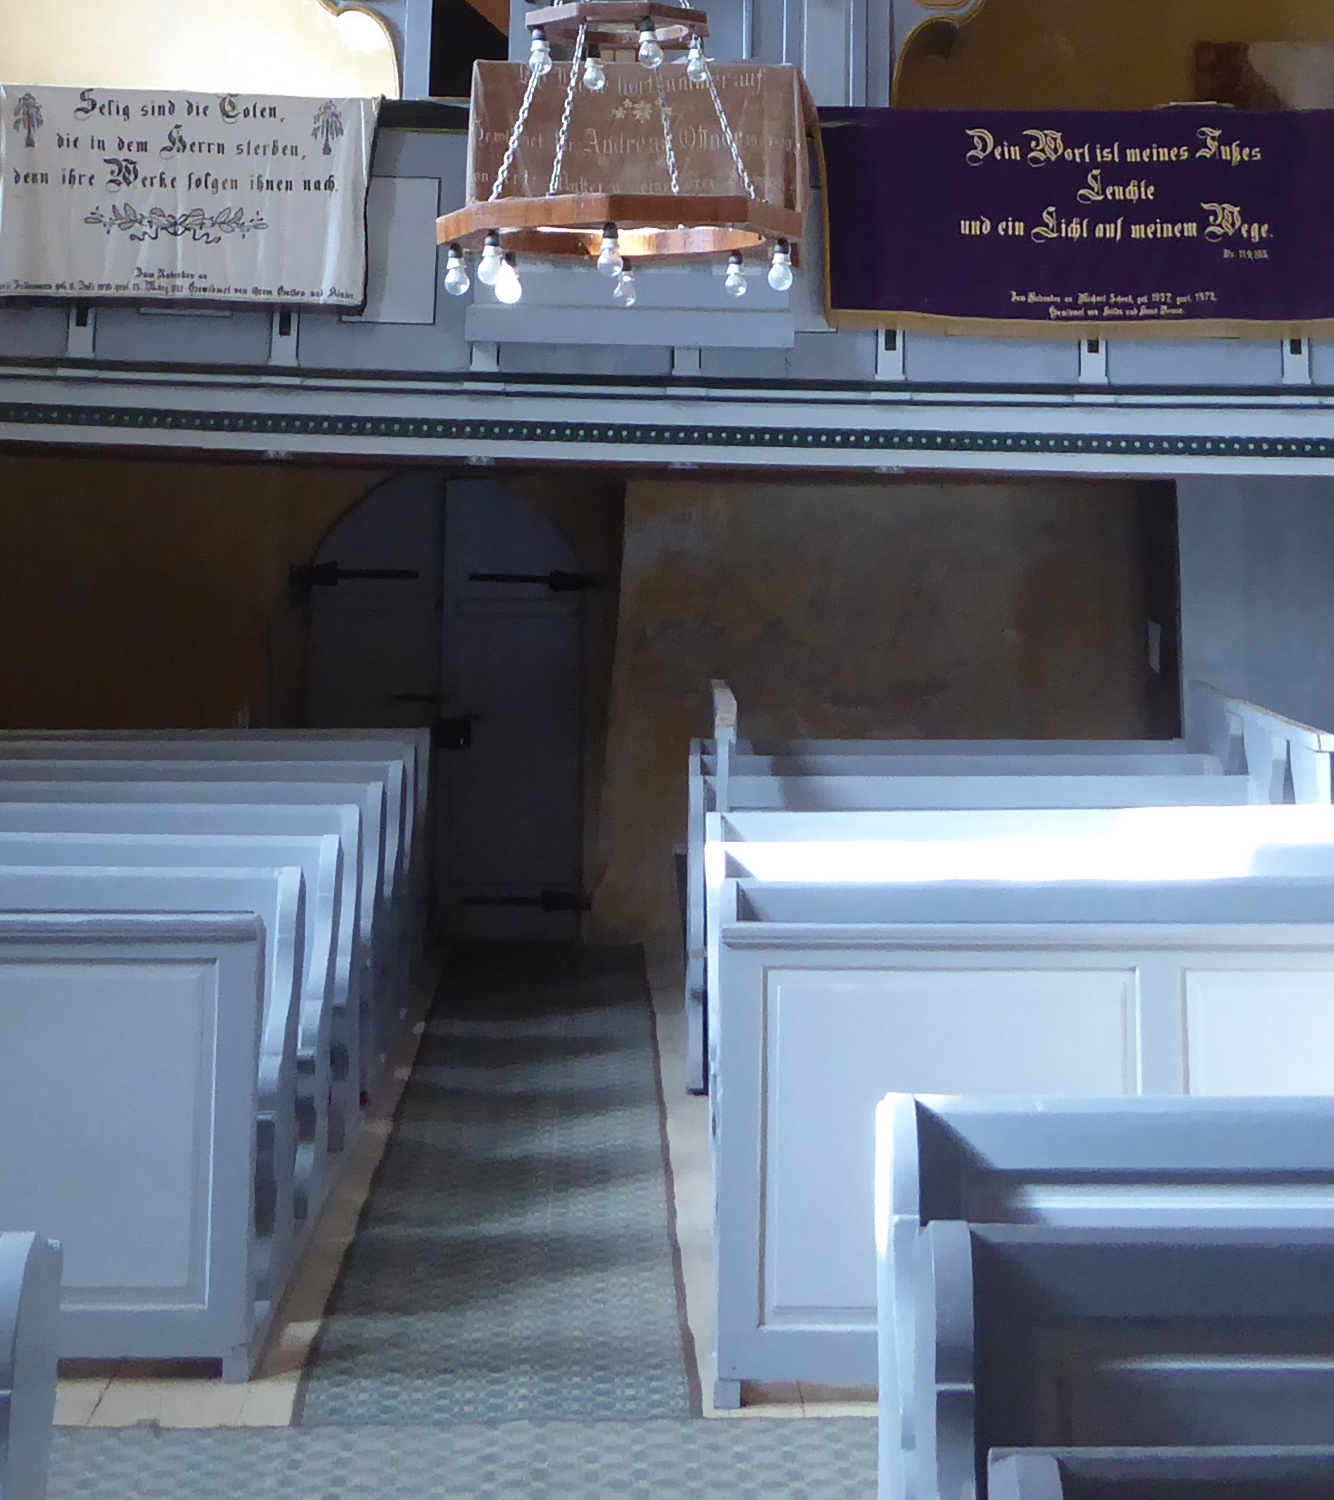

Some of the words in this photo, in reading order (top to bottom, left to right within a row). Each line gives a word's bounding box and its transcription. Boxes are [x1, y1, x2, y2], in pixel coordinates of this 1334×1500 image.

[73, 88, 130, 121] Selig
[141, 100, 176, 117] sind
[186, 100, 208, 117] die
[57, 133, 79, 149] die
[91, 134, 105, 150] in
[118, 136, 148, 152] dem
[159, 123, 225, 159] Herrn
[965, 128, 1020, 167] Dein
[1022, 129, 1091, 168] Wort
[1095, 141, 1120, 163] ist
[1126, 143, 1188, 163] meines
[1195, 127, 1262, 167] Fußes
[14, 168, 49, 185] denn
[62, 168, 95, 189] ihre
[102, 158, 176, 193] Werke
[188, 172, 239, 193] folgen
[249, 174, 293, 193] ihnen
[1076, 169, 1155, 204] Leuchte
[960, 216, 991, 236] und
[998, 217, 1025, 237] ein
[1030, 206, 1088, 243] Licht
[1094, 217, 1124, 243] auf
[1130, 218, 1198, 239] meinem
[1200, 202, 1274, 243] Wege.
